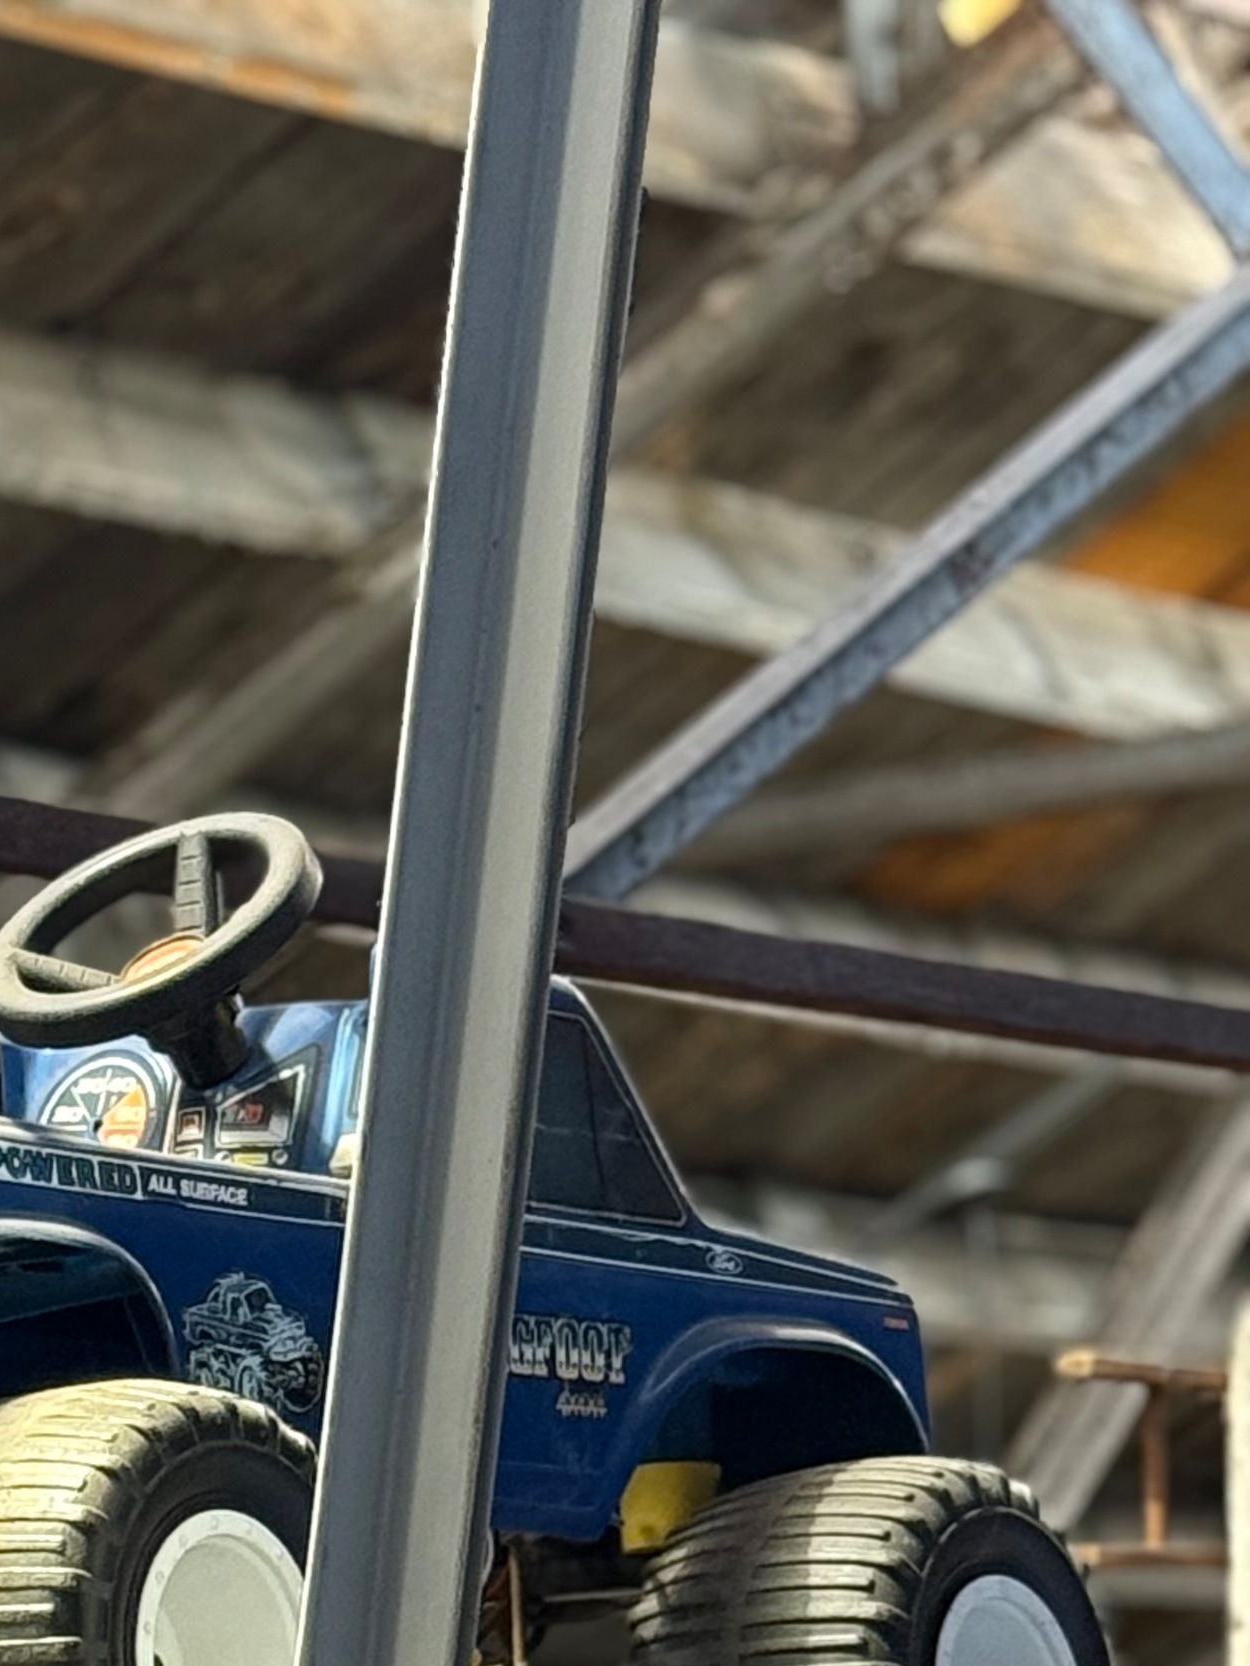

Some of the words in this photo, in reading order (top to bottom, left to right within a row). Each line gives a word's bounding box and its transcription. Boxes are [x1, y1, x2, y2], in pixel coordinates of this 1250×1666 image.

[148, 1172, 177, 1195] ALL
[179, 1178, 249, 1206] SURFACE
[509, 1314, 633, 1384] GFOOT
